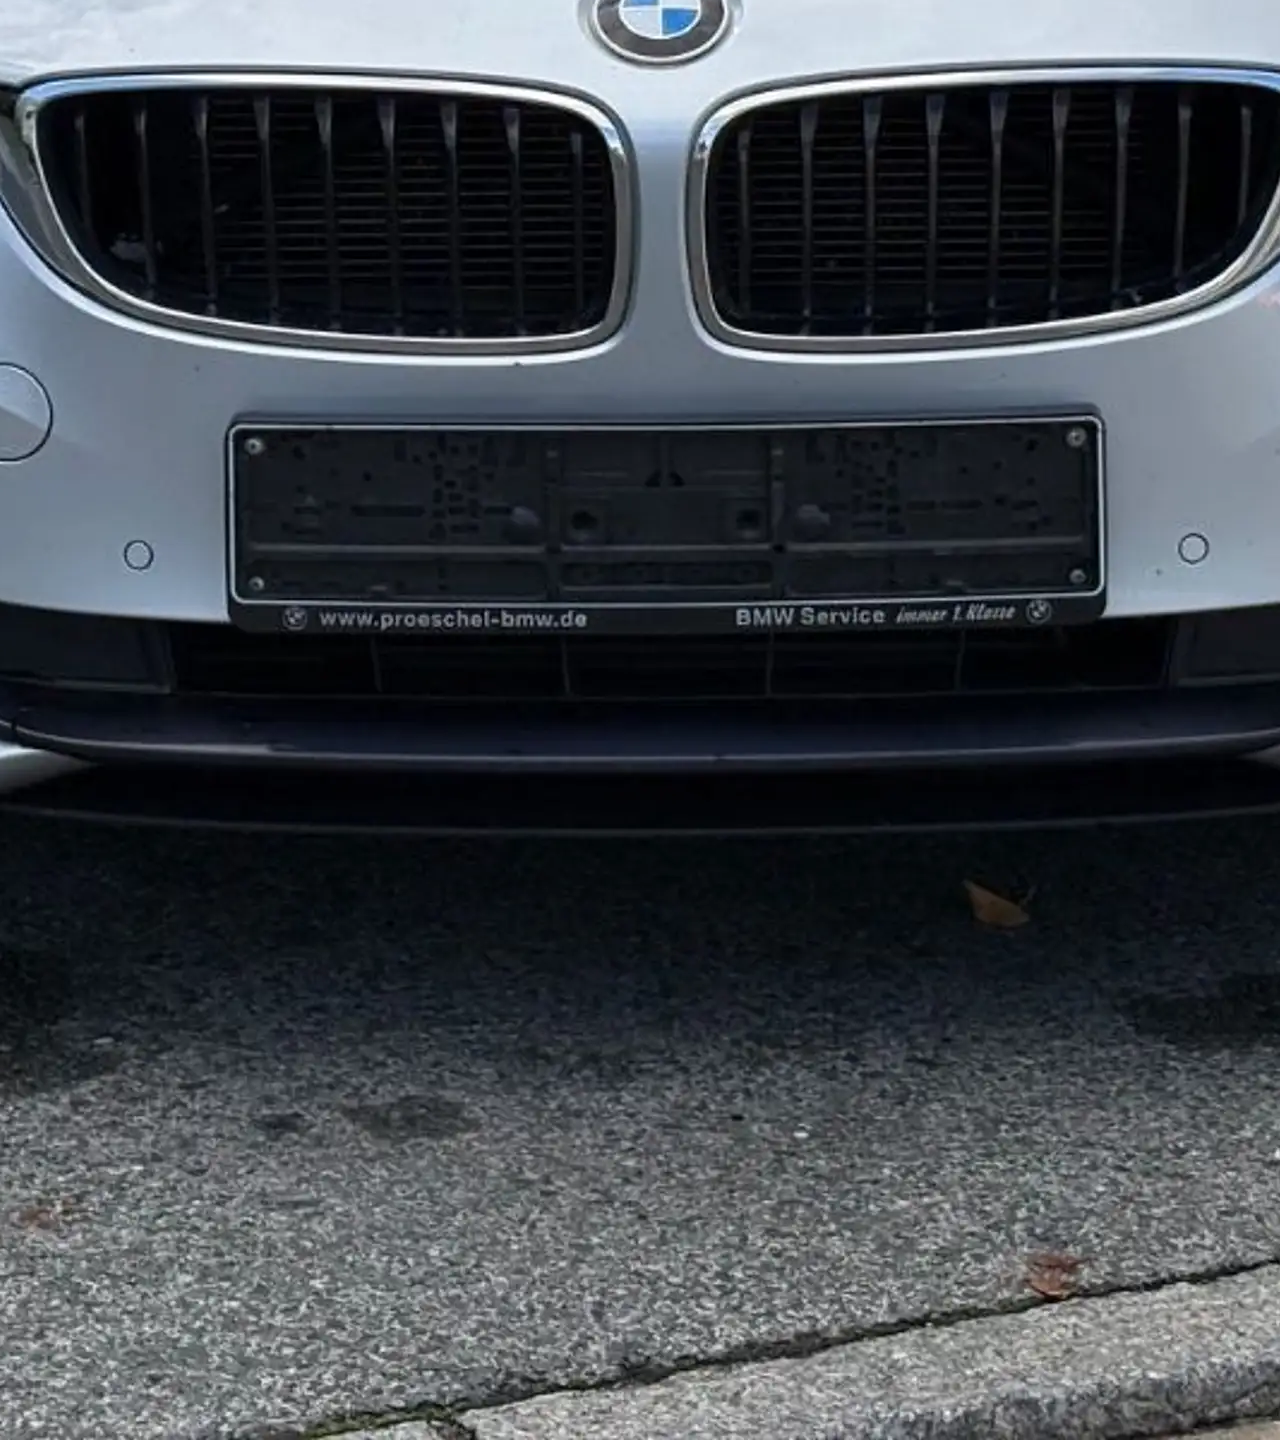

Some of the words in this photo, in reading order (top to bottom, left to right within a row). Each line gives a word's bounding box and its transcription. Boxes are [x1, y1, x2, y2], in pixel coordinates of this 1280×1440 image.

[319, 609, 588, 631] www.proeschel-bmw.de
[735, 607, 795, 627] BMW
[800, 606, 885, 626] Service
[896, 605, 948, 624] immer
